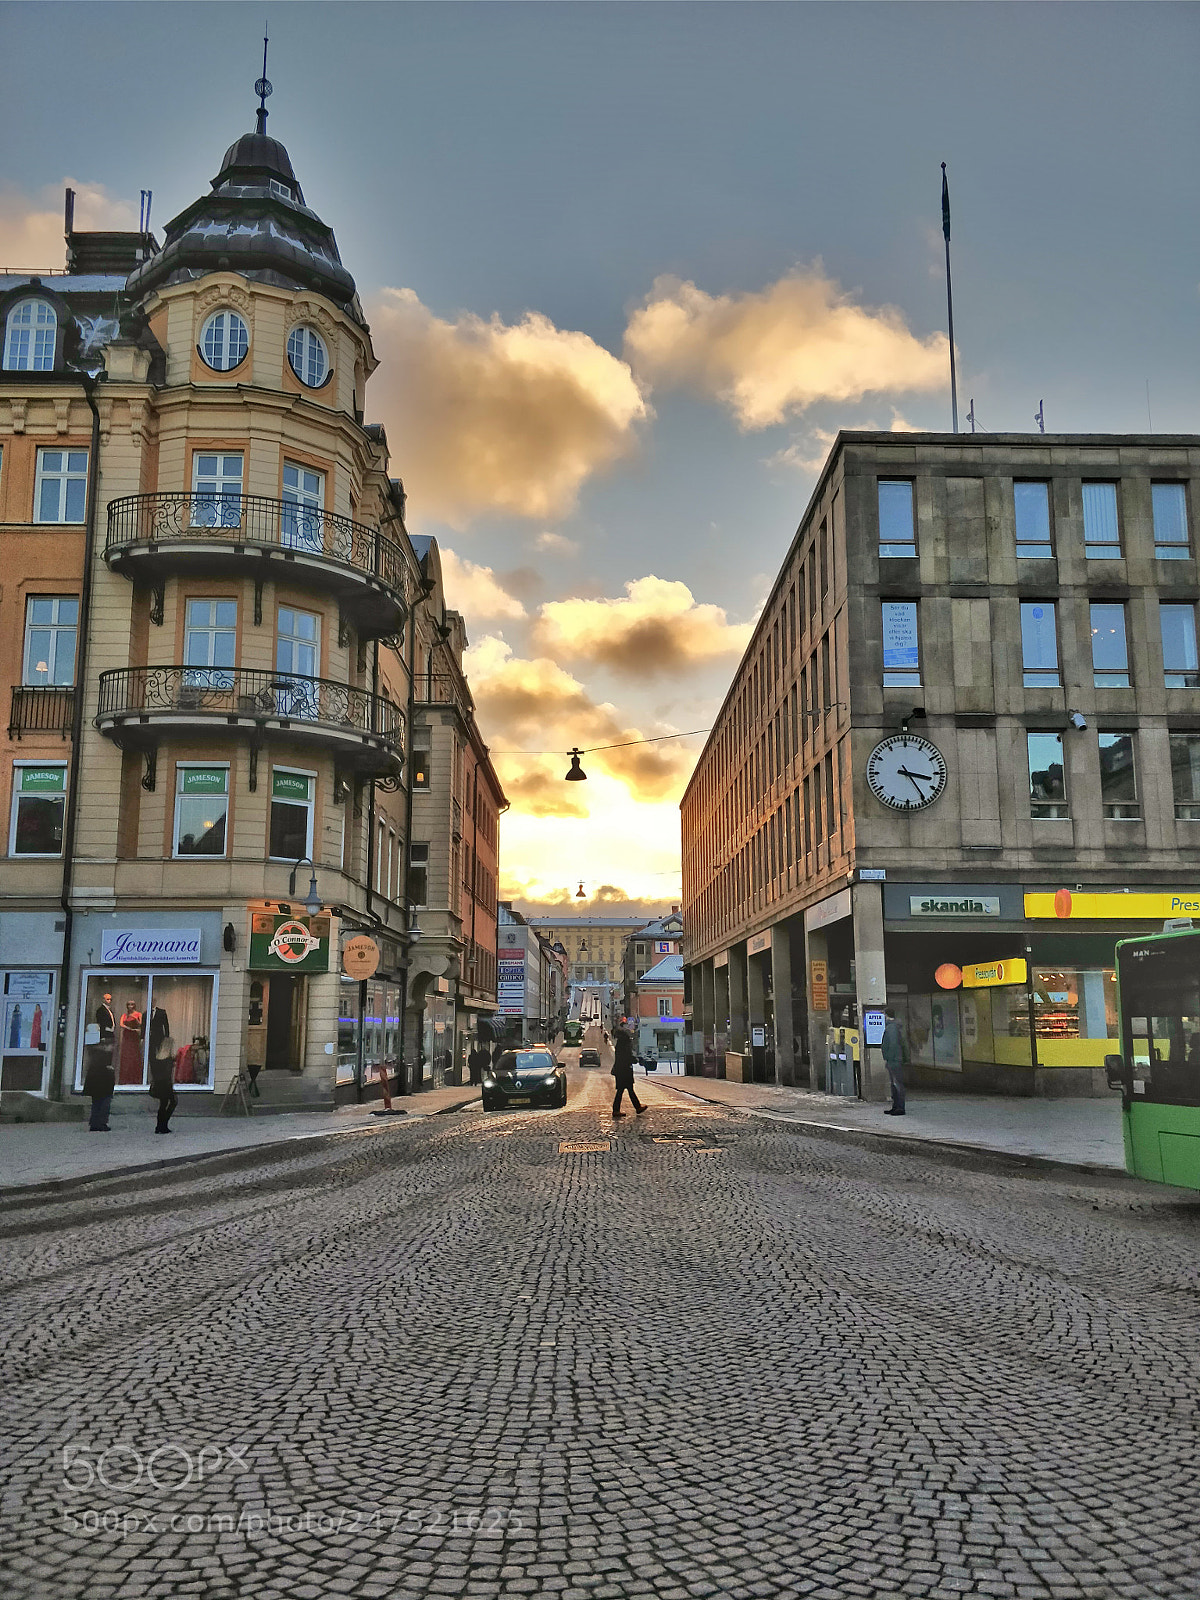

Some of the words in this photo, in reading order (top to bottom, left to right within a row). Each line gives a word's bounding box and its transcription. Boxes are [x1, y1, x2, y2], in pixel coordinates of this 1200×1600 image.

[25, 772, 59, 782] JAMESON
[187, 774, 221, 784] JAMESON
[276, 779, 304, 790] JAMESON
[920, 899, 983, 913] skandia
[104, 932, 199, 961] Joumana
[348, 944, 376, 952] JAMESON
[1132, 950, 1150, 958] MAN
